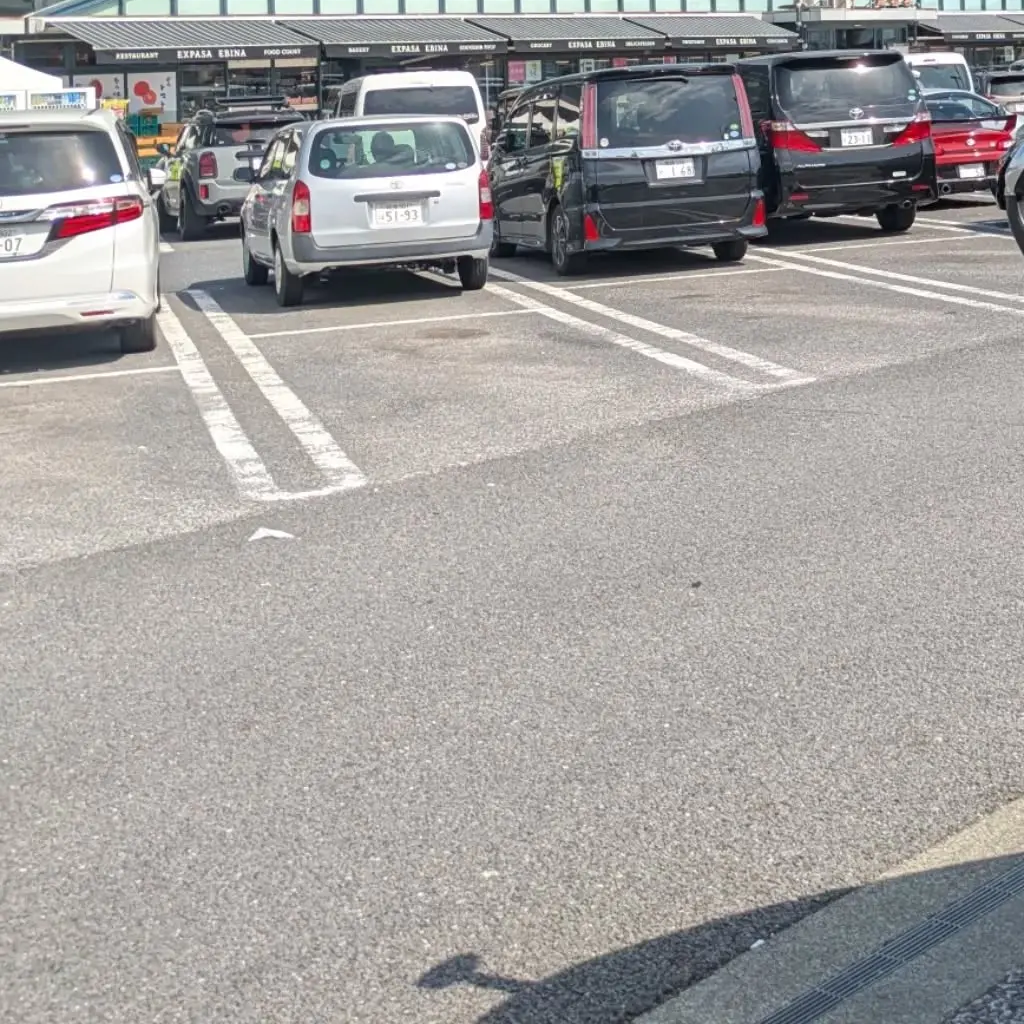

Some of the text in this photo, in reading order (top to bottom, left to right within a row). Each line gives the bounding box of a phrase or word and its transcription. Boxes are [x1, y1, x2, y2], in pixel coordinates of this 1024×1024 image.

[391, 44, 449, 53] EXPASA EBINA
[115, 52, 159, 60] RESTAURANT
[177, 48, 247, 59] EXPASA EBINA
